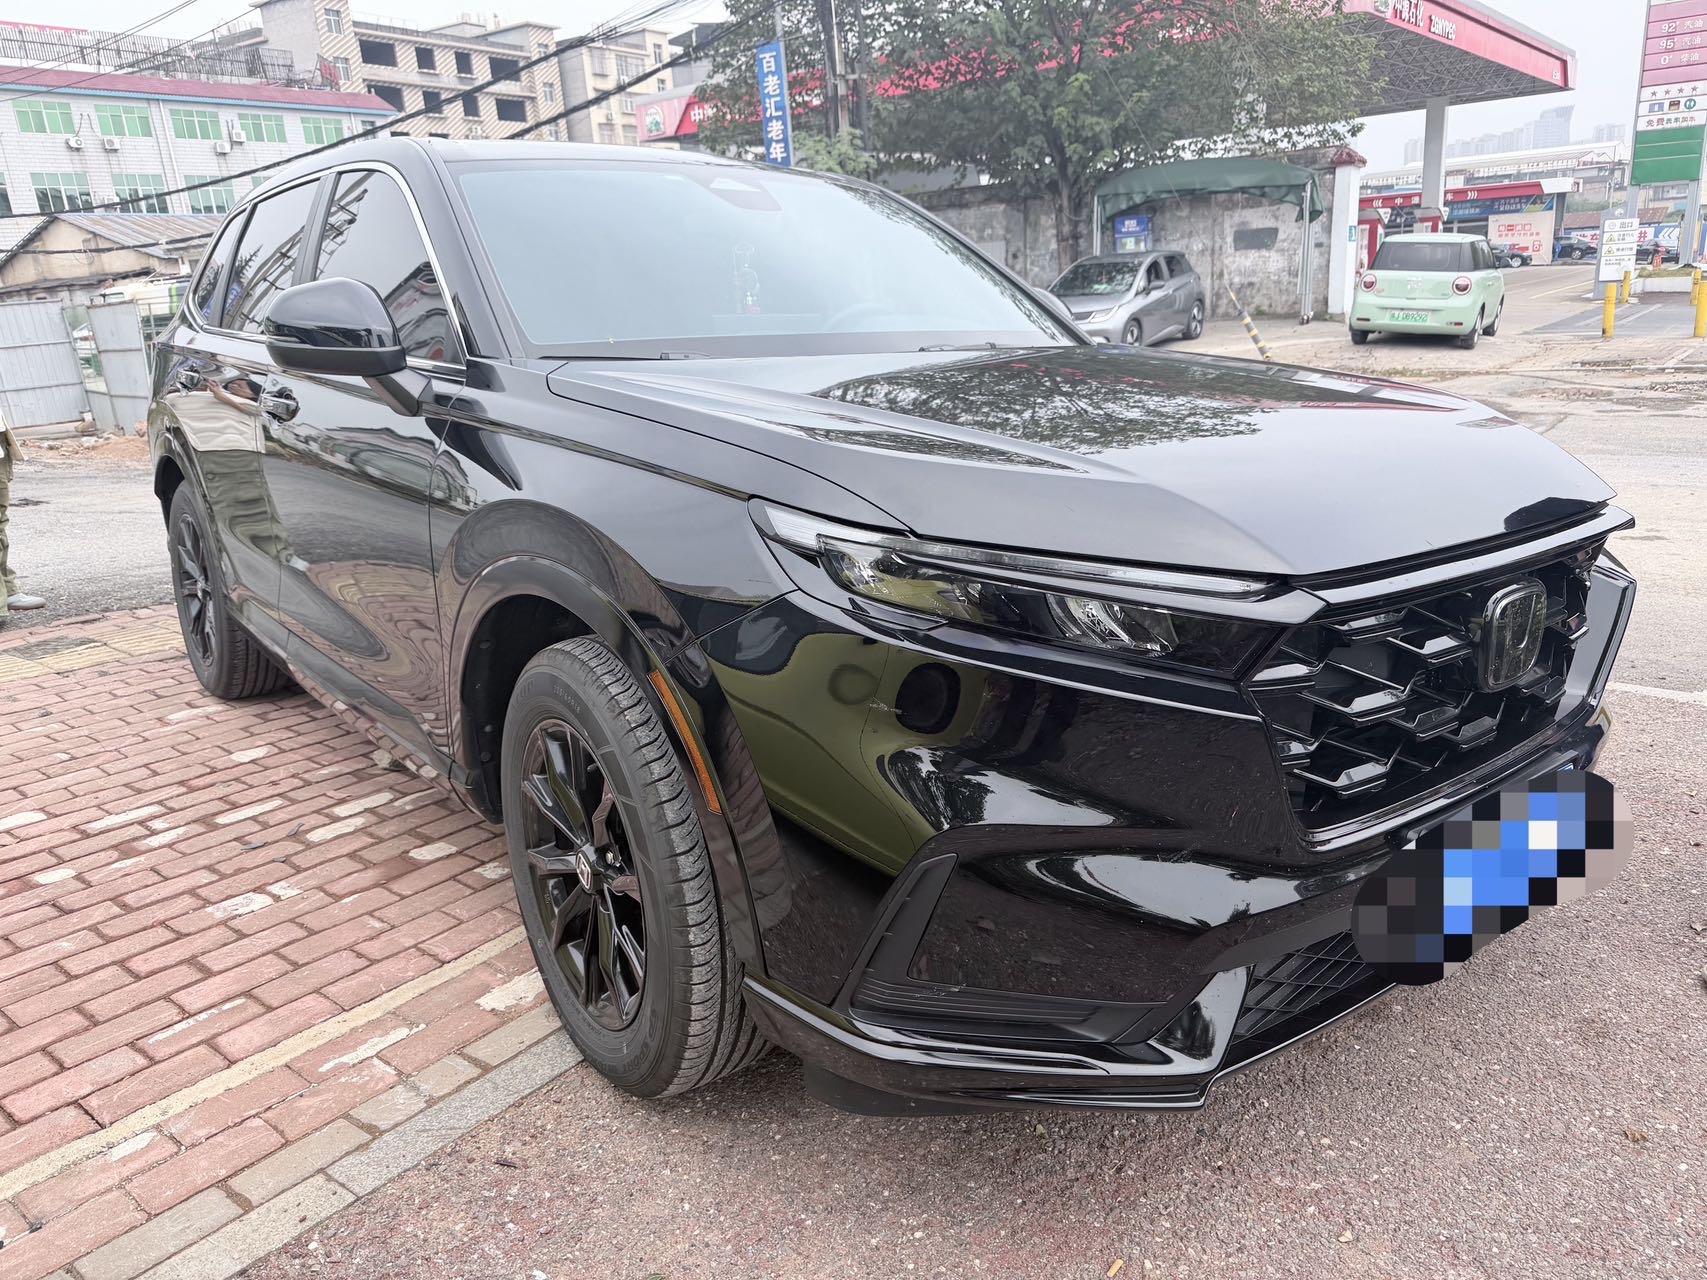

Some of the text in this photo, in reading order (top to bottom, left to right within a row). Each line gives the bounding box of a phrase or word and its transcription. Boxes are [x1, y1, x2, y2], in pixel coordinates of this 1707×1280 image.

[759, 51, 787, 162] 百老汇老年
[1619, 221, 1633, 229] 出口
